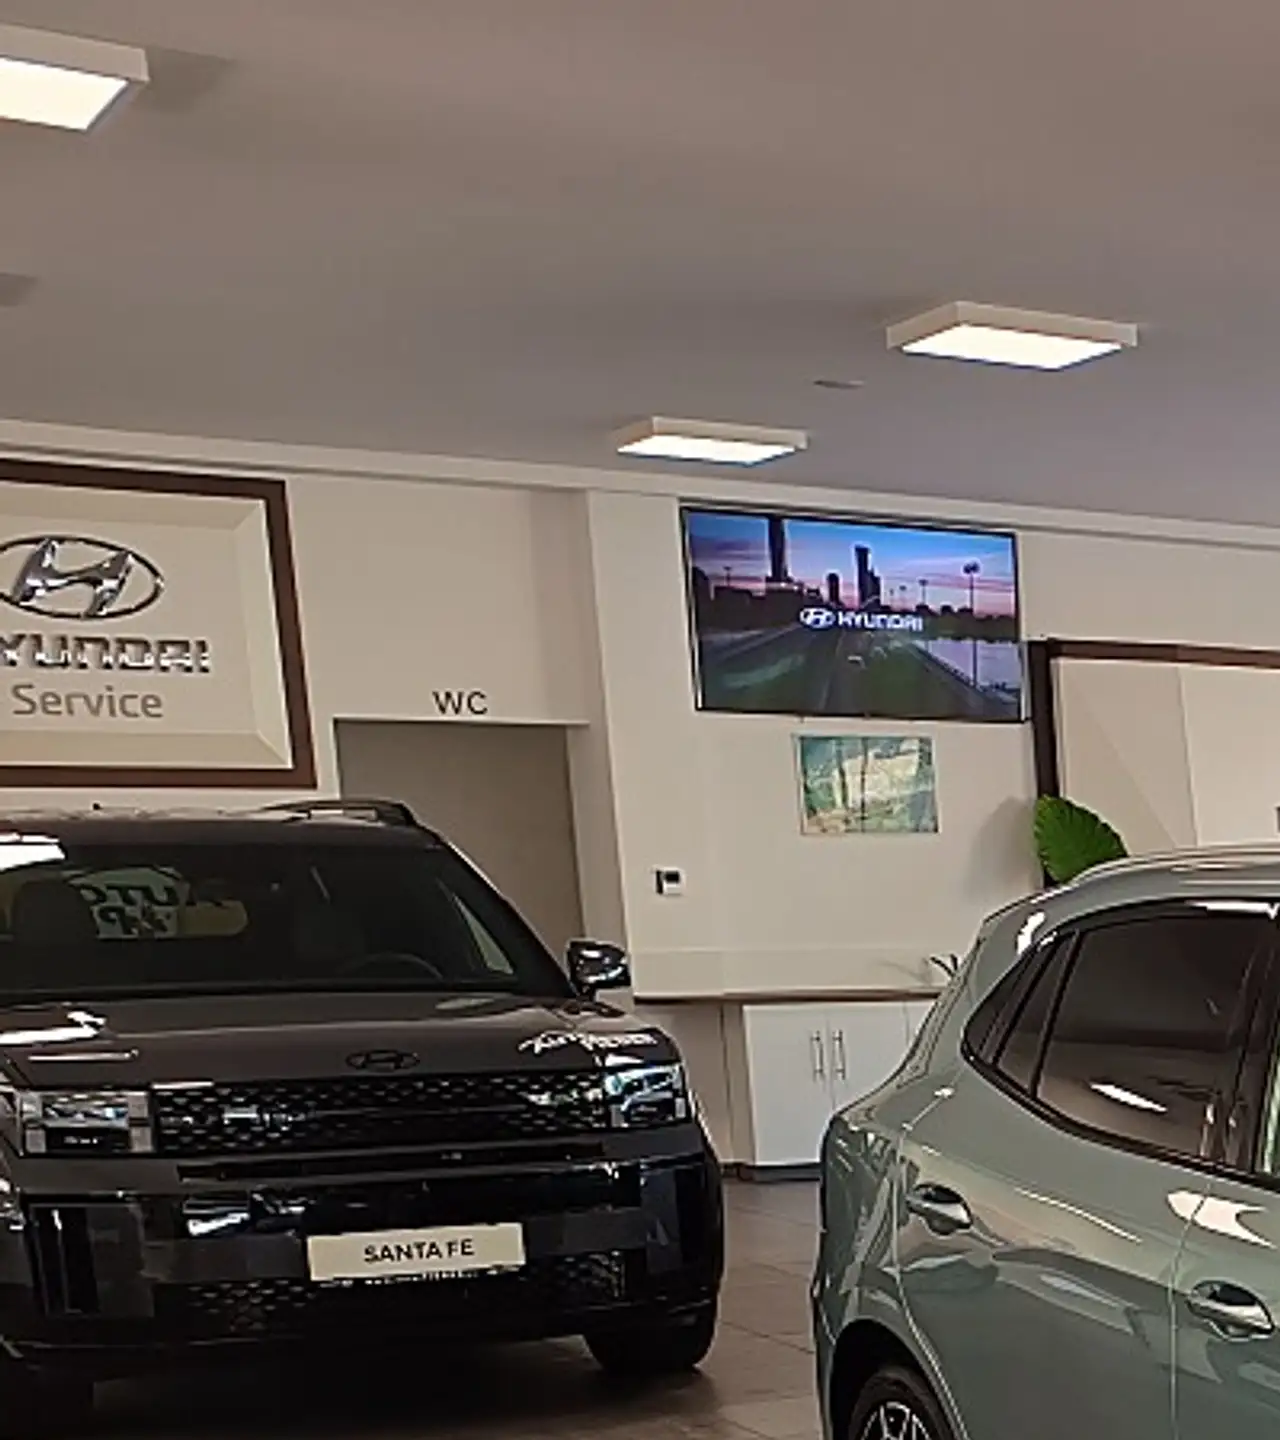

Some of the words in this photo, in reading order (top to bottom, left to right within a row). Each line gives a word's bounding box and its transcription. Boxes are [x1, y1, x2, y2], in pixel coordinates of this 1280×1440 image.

[837, 611, 923, 631] HYUNDAI
[12, 684, 163, 718] Service
[432, 691, 488, 715] WC
[364, 1241, 443, 1263] SANTA
[447, 1238, 475, 1257] FE
